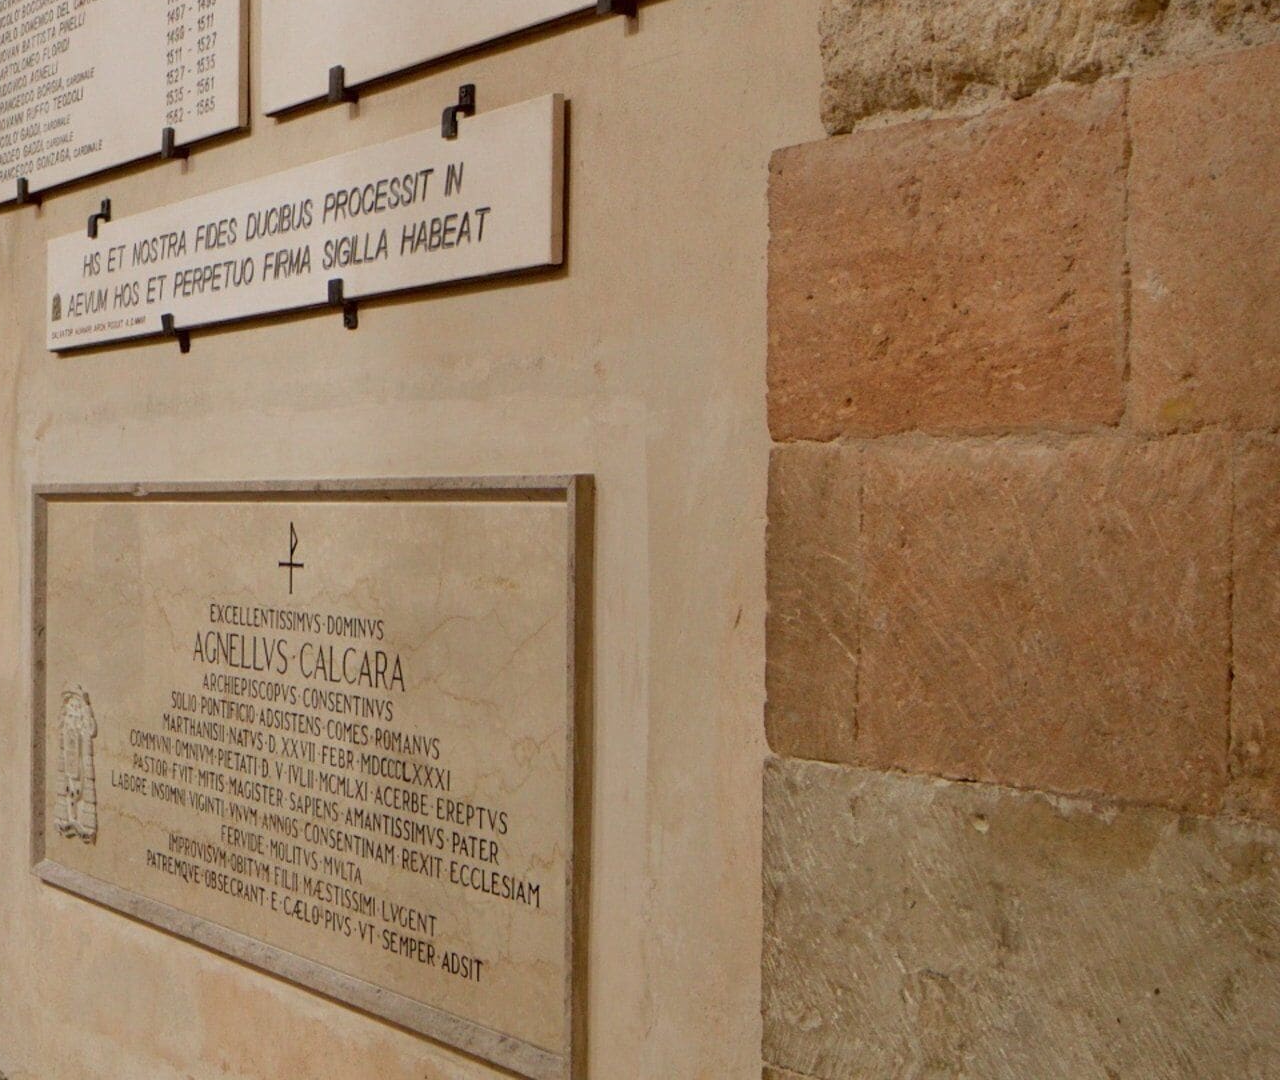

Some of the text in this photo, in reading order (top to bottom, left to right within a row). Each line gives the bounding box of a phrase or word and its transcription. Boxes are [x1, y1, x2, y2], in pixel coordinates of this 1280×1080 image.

[67, 207, 491, 317] AEVUM HOS ET PERPETUO FIRMA SIGILLA HABEAT
[83, 161, 464, 277] HIS ET NOSTRA FIDES DUCIBUS PROCESSIT IN
[193, 631, 405, 692] AGNELLVS CALCARA
[210, 603, 384, 641] EXCELLENTISSIMVS DOMINVS
[171, 690, 440, 760] SOLIO PONTIFICIO ADSISTENS COMES ROMANVS
[203, 673, 393, 722] ARCHIEPISCOPVS CONSENTINVS
[129, 729, 171, 754] COMMVNI
[175, 739, 214, 764] OMNIVM
[218, 748, 257, 775] PIETATI
[275, 761, 284, 781] V
[288, 764, 314, 789] IVLII
[319, 771, 368, 801] MCMLXI
[374, 786, 429, 816] ACERBE
[436, 797, 508, 835] EREPTVS
[163, 713, 225, 742] MARTHANISII
[229, 727, 263, 751] NATVS
[281, 737, 316, 763] XXVII
[321, 744, 354, 770] FEBR
[360, 753, 451, 791] MDCCCLXXXI
[111, 770, 540, 908] LABORE INSOMNI VIGINTI VNVM ANNOS CONSENTINAM REXIT ECCLESIAM
[133, 753, 499, 865] PASTOR FVIT MITIS MAGISTER SAPIENS AMANTISSIMVS PATER
[220, 824, 362, 885] FERVIDE MOLITVS MVLTA
[146, 849, 484, 982] PATREMQVE OBSECRANT E CÆLO PIVS VT SEMPER ADSIT
[168, 833, 437, 937] IMPROVISVM OBITVM FILII MÆSTISSIMI LVGENT
